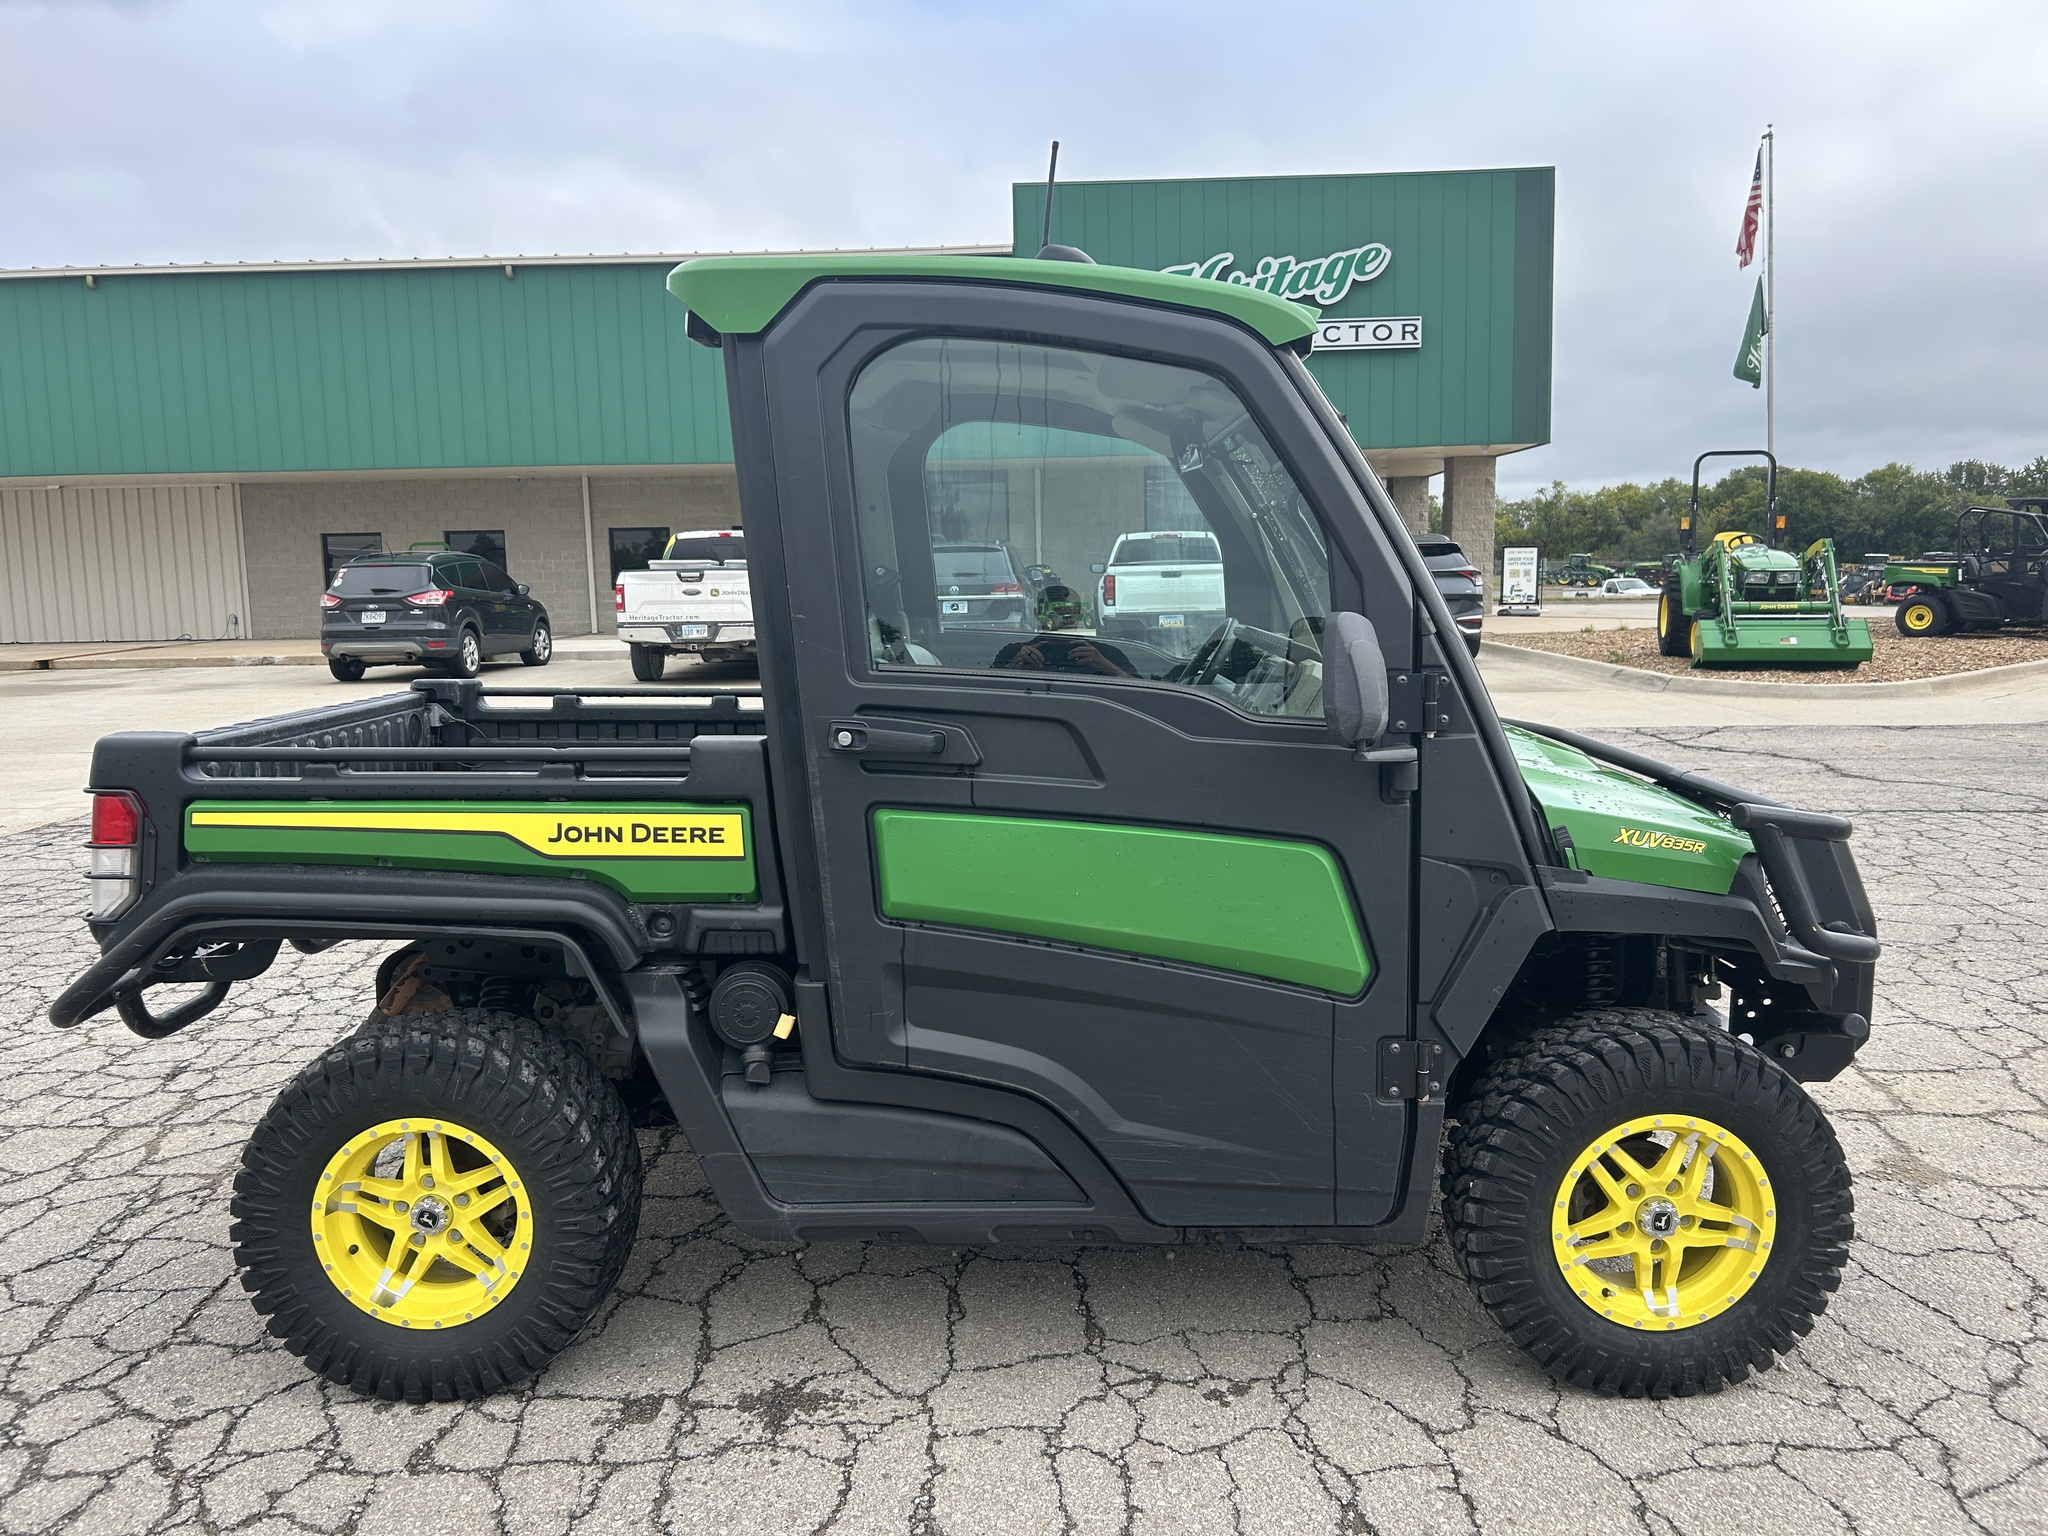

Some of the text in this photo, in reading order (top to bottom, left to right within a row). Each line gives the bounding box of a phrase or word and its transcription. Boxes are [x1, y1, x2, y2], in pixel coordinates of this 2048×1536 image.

[1158, 243, 1391, 305] itage
[1321, 323, 1419, 343] CTOR
[629, 614, 700, 622] HeritageTractor.com
[548, 822, 725, 844] JOHN DEERE
[1610, 827, 1707, 855] XUV835R
